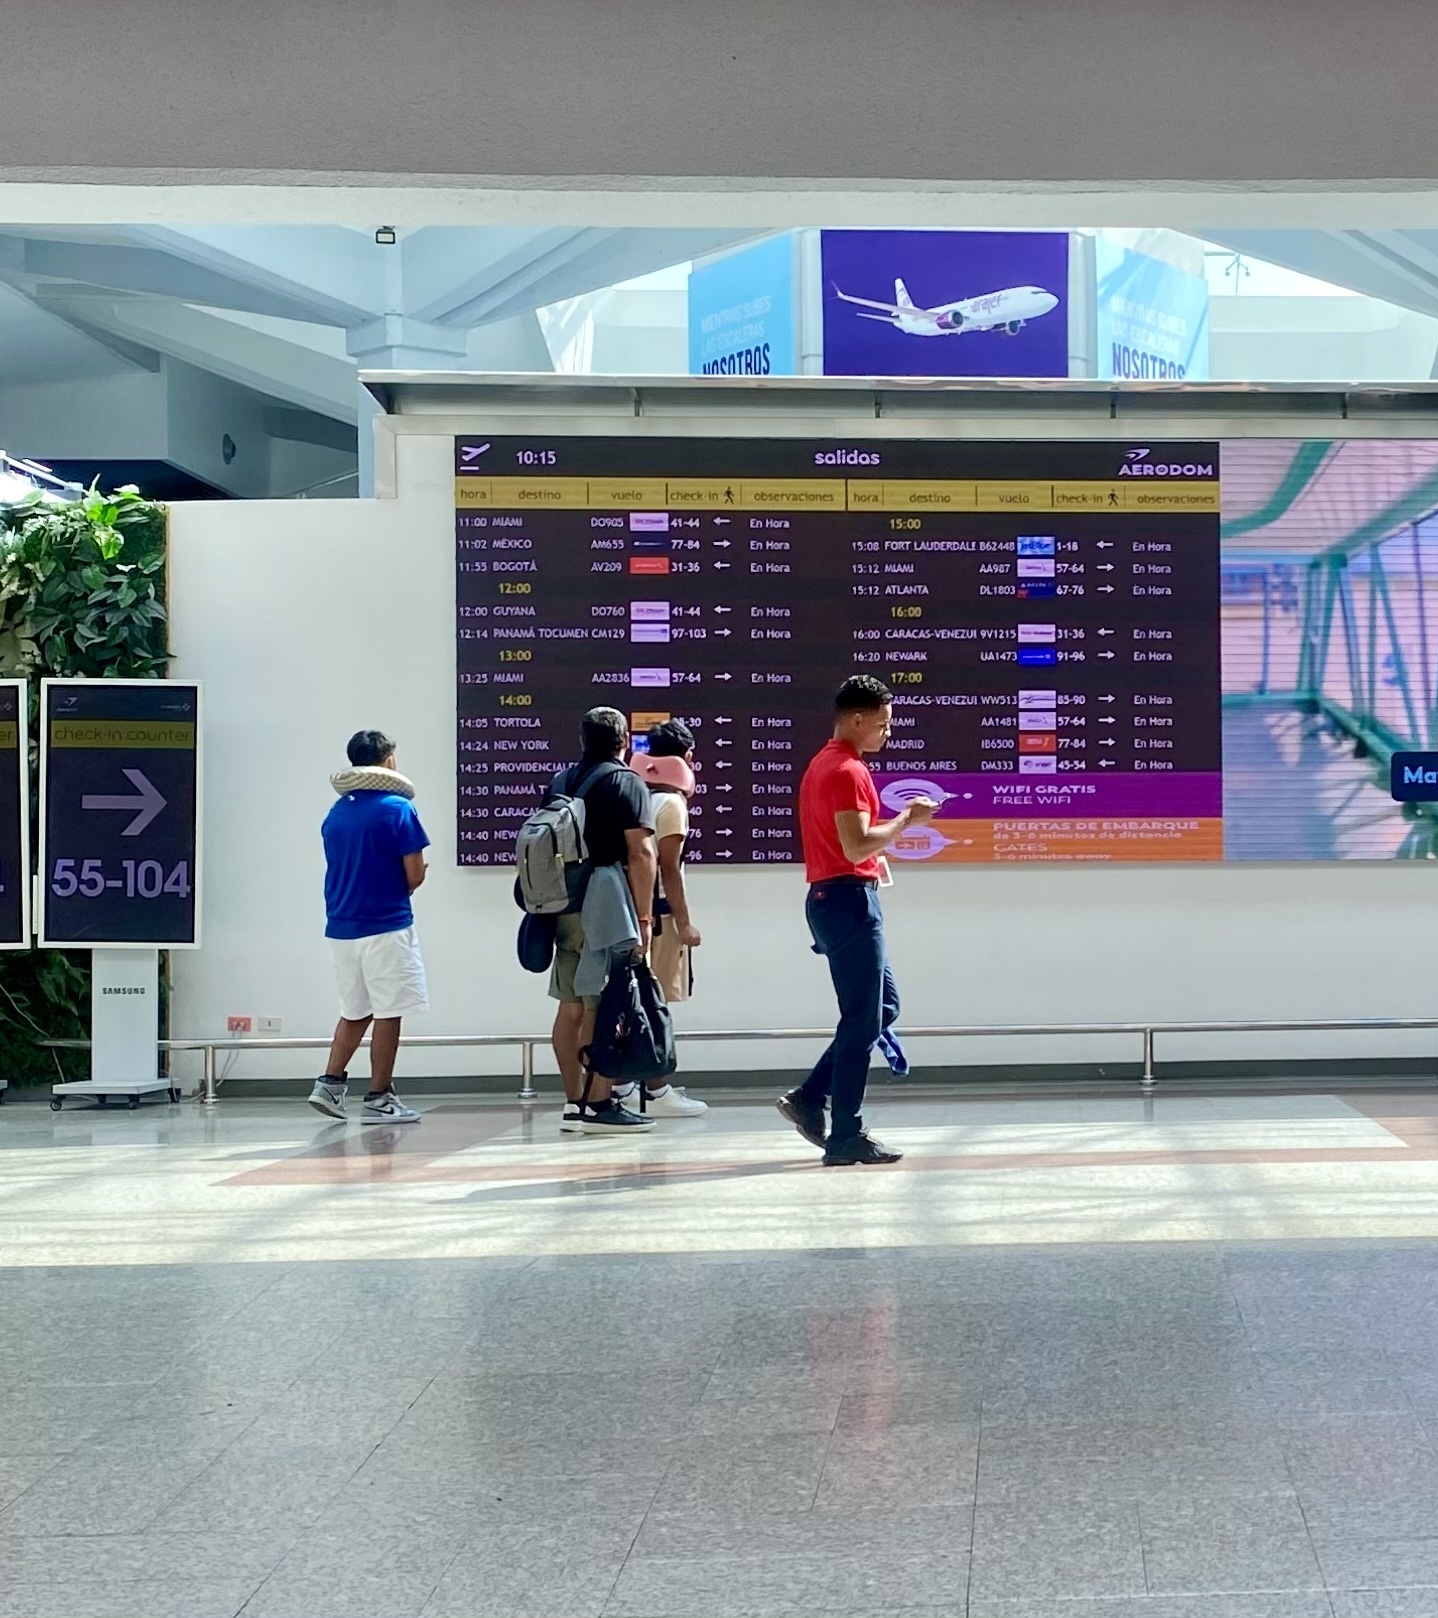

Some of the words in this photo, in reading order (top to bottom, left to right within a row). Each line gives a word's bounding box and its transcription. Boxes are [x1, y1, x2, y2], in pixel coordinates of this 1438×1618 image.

[517, 451, 556, 464] 10:15
[815, 450, 879, 464] salidas
[1119, 465, 1212, 475] AERODOM
[461, 488, 486, 500] hora
[518, 488, 561, 500] destino
[611, 488, 642, 500] vuelo
[670, 488, 718, 500] check-in
[754, 488, 834, 501] observaciones
[854, 491, 879, 503] hora
[909, 491, 951, 503] destino
[999, 492, 1029, 504] vuelo
[1056, 492, 1103, 504] check-in
[1137, 493, 1215, 505] observaciones
[459, 518, 487, 527] 11:00
[492, 518, 523, 527] MIAMI
[670, 518, 700, 528] 41-44
[750, 519, 762, 528] En
[766, 519, 790, 528] Hora
[890, 519, 921, 530] 15:00
[459, 540, 487, 549] 11:02
[492, 536, 532, 549] MÉXICO
[885, 541, 911, 551] FORT
[1057, 542, 1078, 551] 1-18
[459, 562, 487, 572] 11:55
[493, 559, 538, 572] BOGOTÁ
[671, 562, 700, 572] 31-36
[750, 563, 762, 572] En
[766, 563, 790, 572] Hora
[852, 564, 880, 573] 15:12
[885, 564, 914, 573] MIAMI
[1057, 564, 1084, 573] 57-64
[1132, 564, 1144, 574] En
[1148, 564, 1172, 574] Hora
[498, 583, 531, 594] 12:00
[852, 586, 880, 595] 15:12
[885, 586, 929, 595] ATLANTA
[1057, 586, 1084, 595] 67-76
[459, 607, 488, 616] 12:00
[493, 607, 536, 616] GUYANA
[672, 607, 700, 616] 41-44
[891, 607, 922, 618] 16:00
[459, 629, 488, 639] 12:14
[494, 626, 535, 639] PANAMÁ
[540, 629, 588, 639] TOCUMEN
[592, 629, 625, 639] CM129
[751, 630, 763, 639] En
[767, 630, 790, 639] Hora
[853, 630, 880, 639] 16:00
[980, 630, 1016, 639] 9V1215
[1058, 630, 1085, 639] 31-36
[1134, 630, 1146, 639] En
[1150, 630, 1173, 639] Hora
[500, 650, 532, 661] 13:00
[853, 652, 880, 661] 16:20
[886, 652, 928, 661] NEWARK
[1058, 652, 1086, 661] 91-96
[459, 674, 488, 683] 13:25
[494, 674, 524, 683] MIAMI
[592, 674, 630, 683] AA2836
[672, 673, 701, 683] 57-64
[891, 673, 922, 684] 17:00
[500, 695, 532, 706] 14:00
[1134, 696, 1146, 705] En
[1150, 696, 1174, 705] Hora
[460, 718, 488, 728] 14:05
[494, 718, 541, 728] TORTOLA
[752, 718, 764, 727] En
[768, 718, 791, 727] Hora
[1058, 717, 1086, 726] 57-64
[1134, 718, 1146, 726] En
[1150, 718, 1174, 726] Hora
[54, 727, 122, 742] check-in
[126, 727, 191, 742] counter
[460, 741, 488, 750] 14:24
[494, 741, 517, 750] NEW
[522, 741, 550, 750] YORK
[886, 740, 925, 749] MADRID
[1134, 740, 1146, 749] En
[1150, 740, 1174, 749] Hora
[460, 763, 488, 772] 14:25
[752, 762, 764, 772] En
[768, 762, 791, 772] Hora
[886, 762, 926, 771] BUENOS
[930, 762, 957, 771] AIRES
[1134, 761, 1146, 770] En
[1150, 761, 1174, 770] Hora
[460, 786, 488, 796] 14:30
[494, 783, 536, 796] PANAMÁ
[993, 786, 1030, 794] WIFI
[1034, 786, 1096, 794] GRATIS
[993, 796, 1033, 804] FREE
[1037, 796, 1071, 804] WIFI
[460, 808, 488, 818] 14:30
[752, 806, 764, 816] En
[768, 806, 792, 816] Hora
[994, 822, 1071, 831] PUERTAS
[1076, 822, 1098, 830] DE
[1102, 821, 1199, 830] EMBARQUE
[460, 831, 488, 840] 14:40
[494, 831, 518, 840] NEW
[994, 843, 1048, 852] GATES
[460, 853, 488, 862] 14:40
[494, 853, 518, 862] NEW
[752, 851, 764, 860] En
[768, 851, 792, 860] Hora
[52, 858, 190, 898] 55-104
[102, 987, 146, 995] SAMSUNG
